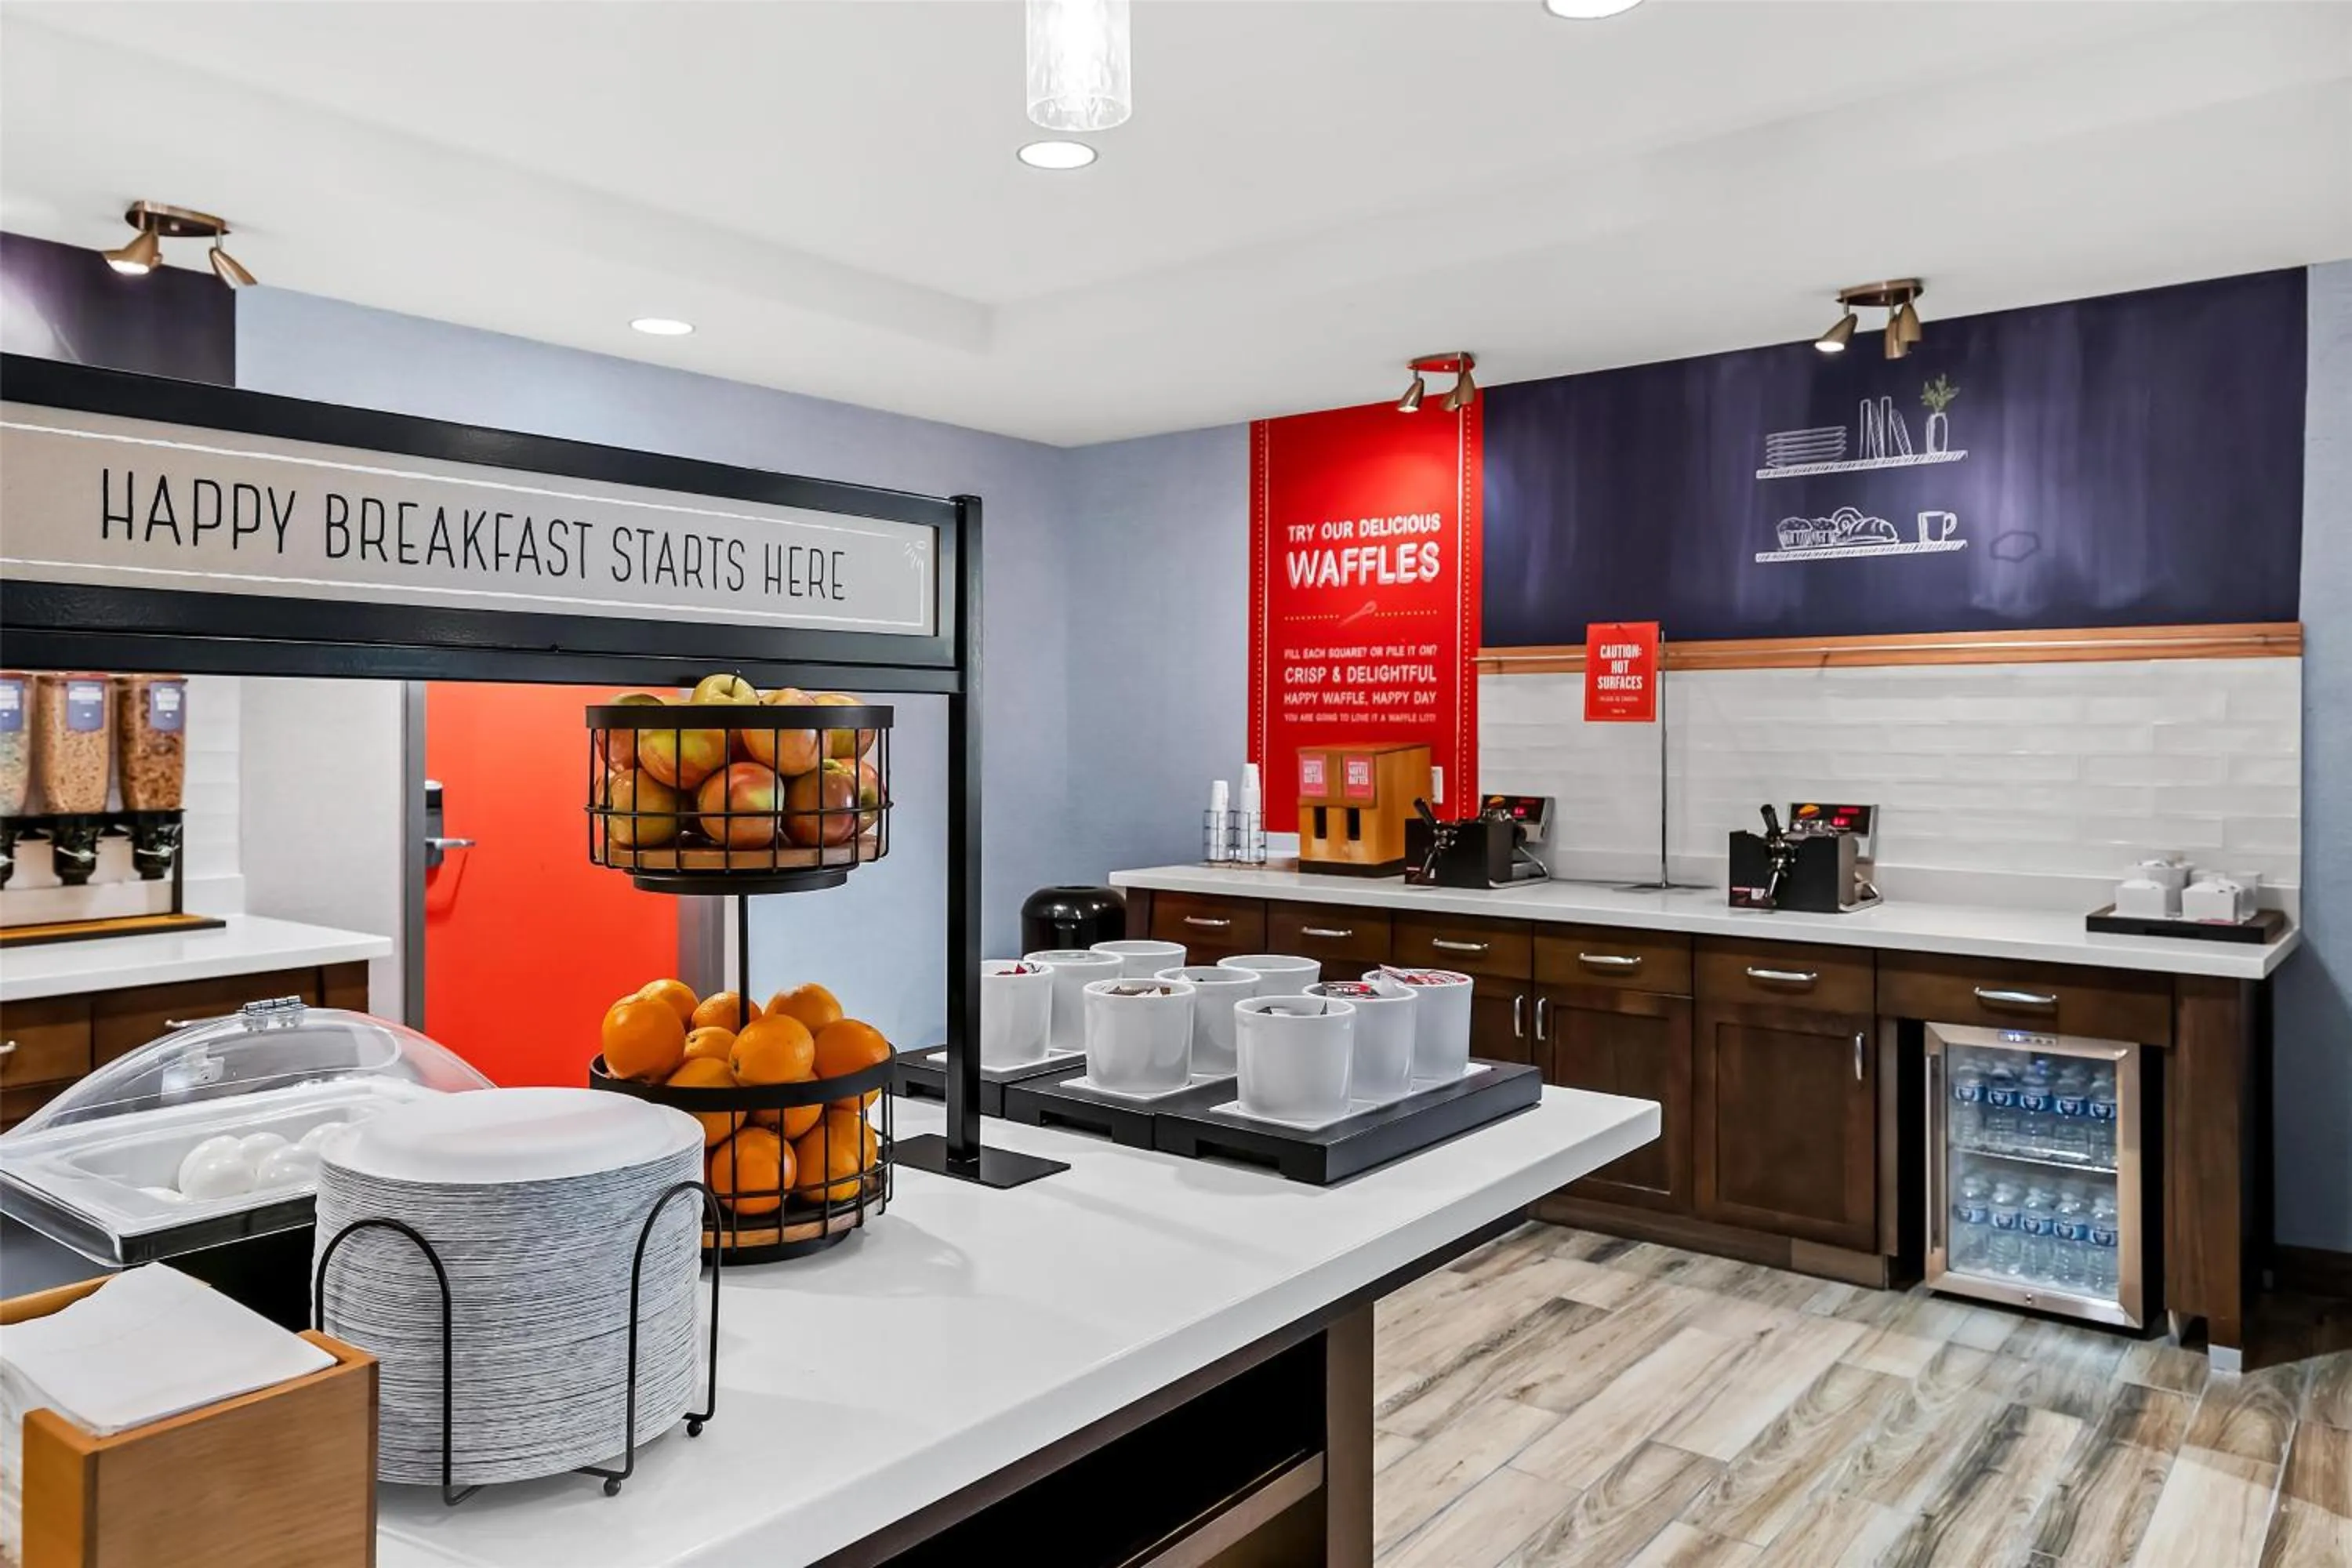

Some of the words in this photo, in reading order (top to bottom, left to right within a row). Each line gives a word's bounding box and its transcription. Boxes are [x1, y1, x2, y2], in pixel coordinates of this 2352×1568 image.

[101, 468, 296, 555] HAPPY
[325, 493, 594, 579] BREAKFAST
[612, 526, 746, 593] STARTS
[764, 543, 847, 601] HERE
[1287, 525, 1315, 542] TRY
[1321, 521, 1353, 540] OUR
[1359, 513, 1441, 536] DELICIOUS
[1287, 541, 1440, 589] WAFFLES
[1284, 648, 1301, 659] FILL
[1303, 648, 1326, 659] EACH
[1370, 645, 1383, 657] OR
[1385, 645, 1405, 657] PILE
[1407, 645, 1416, 656] IT
[1600, 644, 1642, 659] CAUTION:
[1284, 666, 1327, 684] CRISP
[1332, 666, 1341, 683] &
[1346, 664, 1437, 684] DELIGHTFUL
[1611, 659, 1630, 674] HOT
[1597, 676, 1643, 691] SURFACES
[1284, 691, 1318, 705] HAPPY
[1372, 691, 1410, 705] HAPPY
[1414, 691, 1436, 705] DAY
